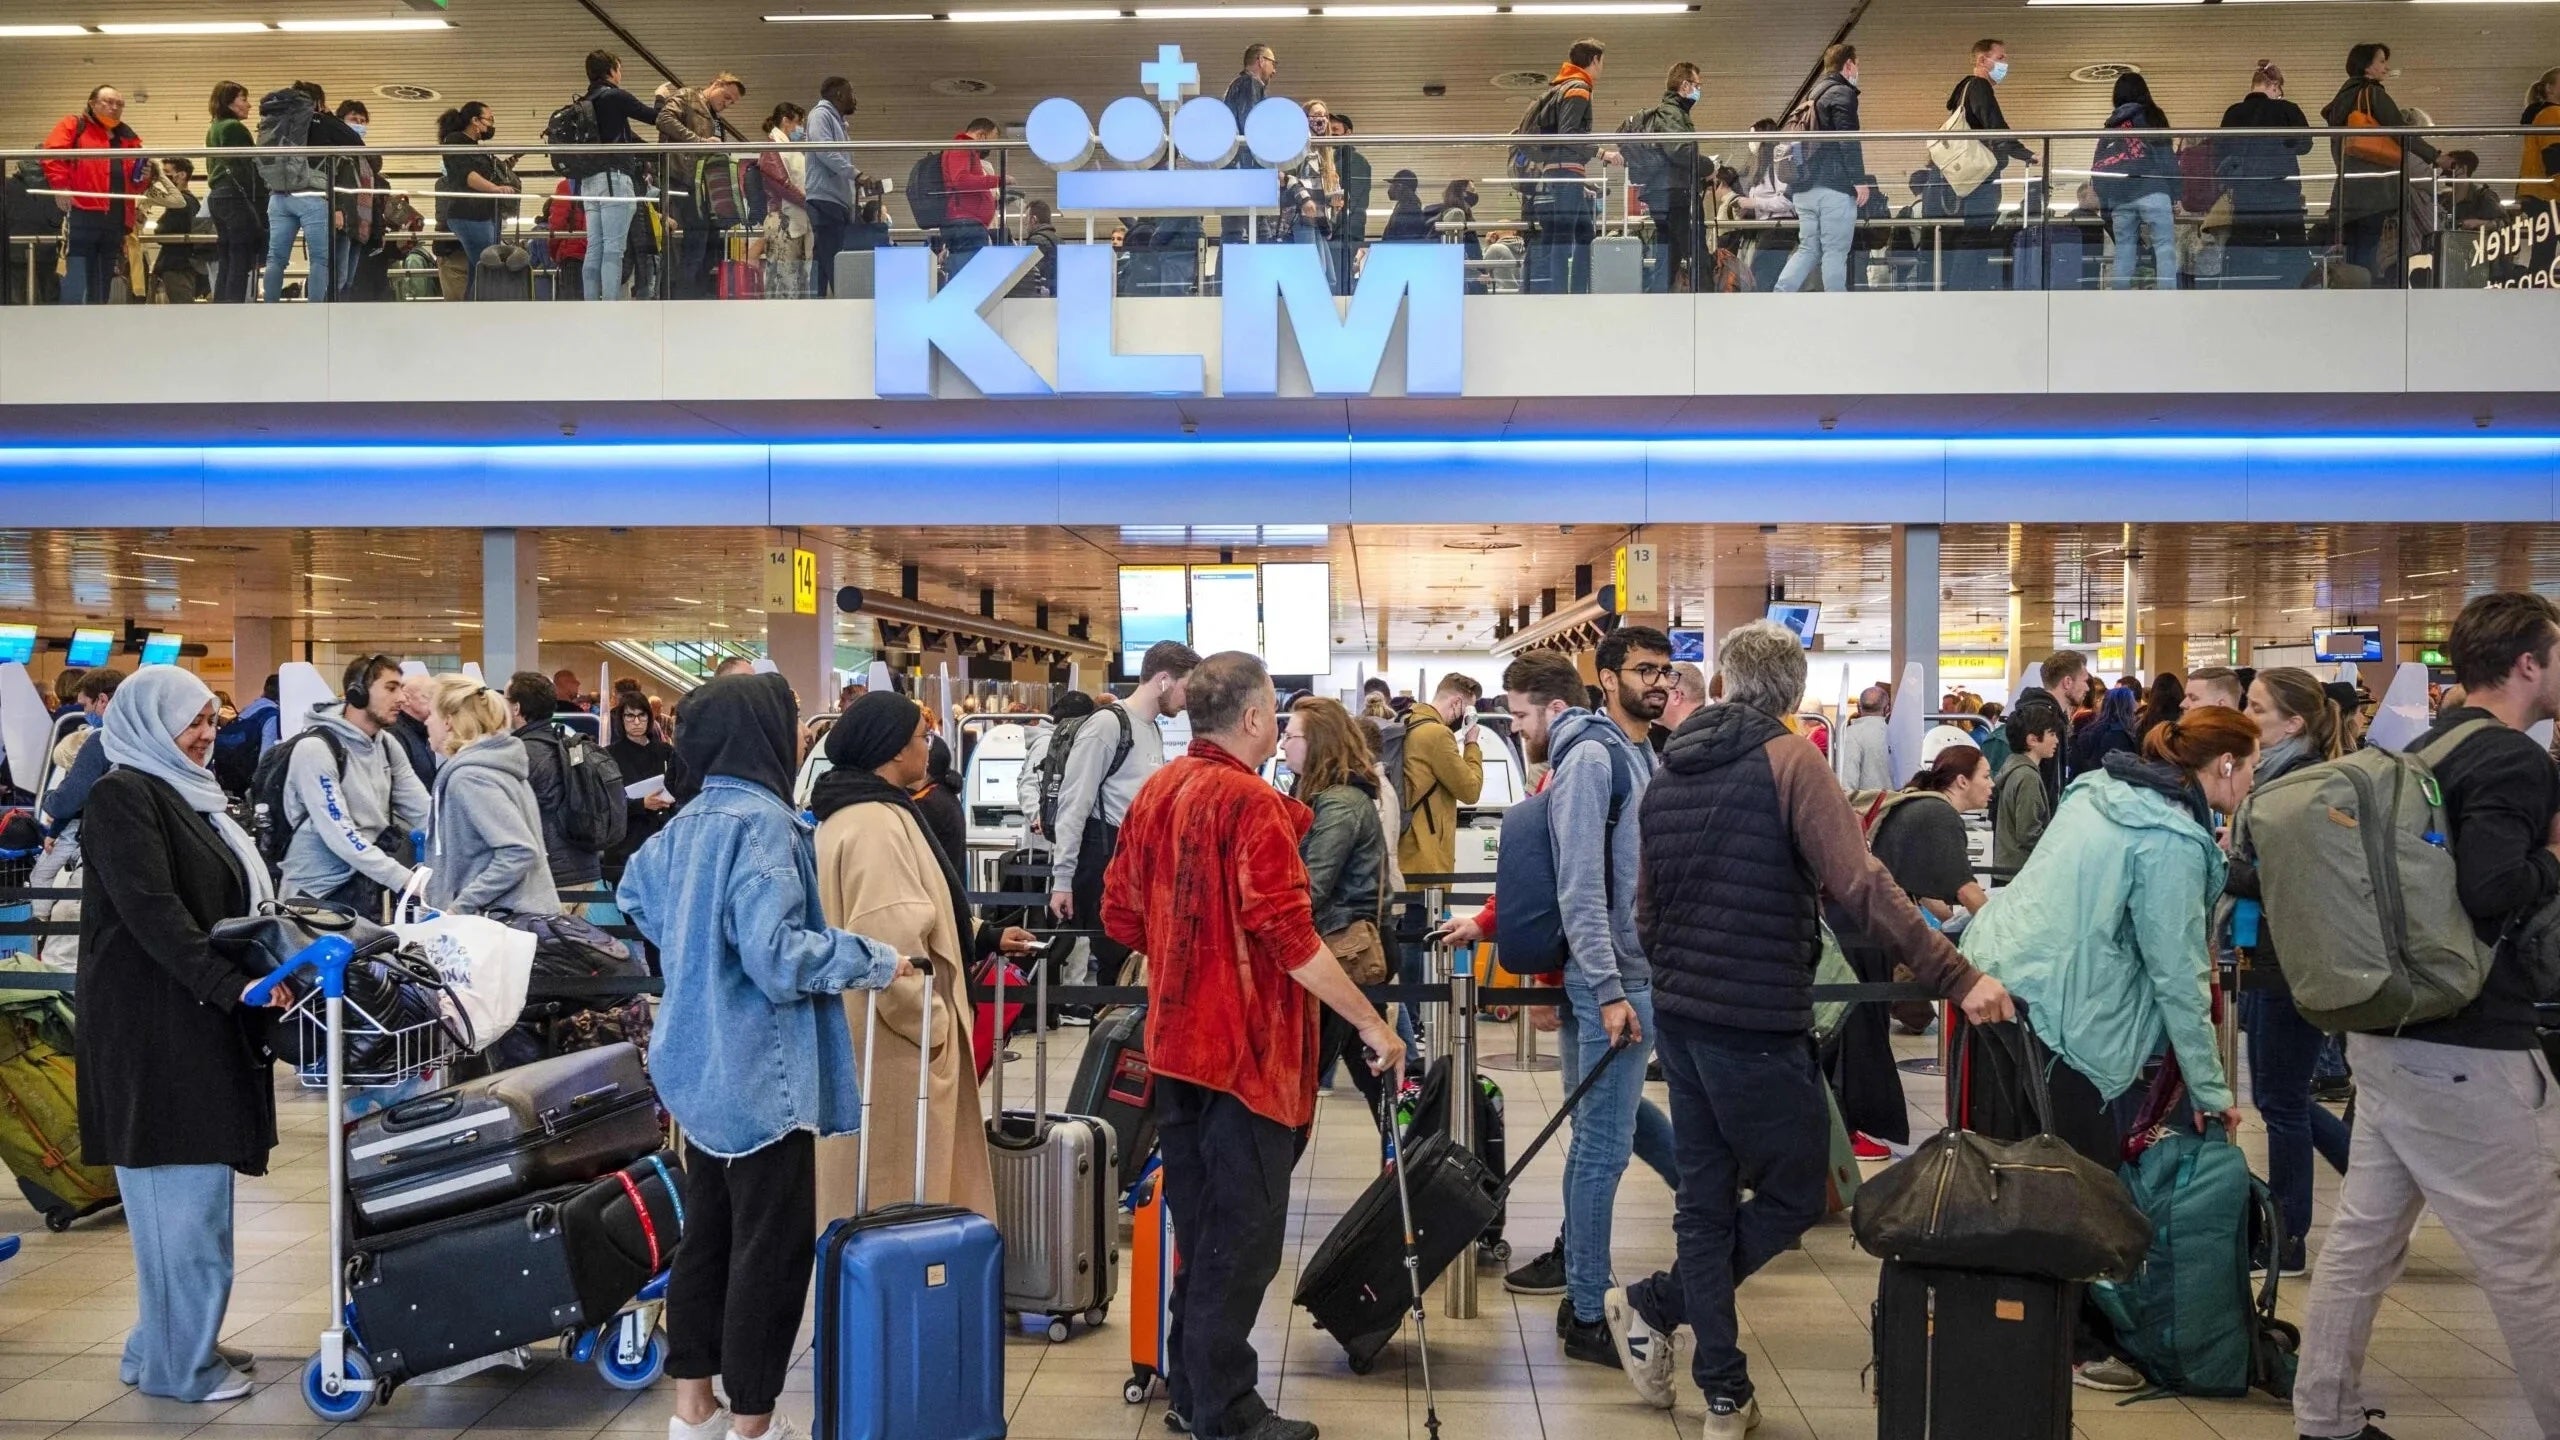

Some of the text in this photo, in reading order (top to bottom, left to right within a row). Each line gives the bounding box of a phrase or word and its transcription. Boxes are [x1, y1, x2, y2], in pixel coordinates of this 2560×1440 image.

[875, 245, 1464, 397] KLM
[770, 552, 785, 564] 14
[1634, 549, 1650, 562] 13
[797, 555, 812, 594] 14
[1713, 1404, 1730, 1412] VEJA
